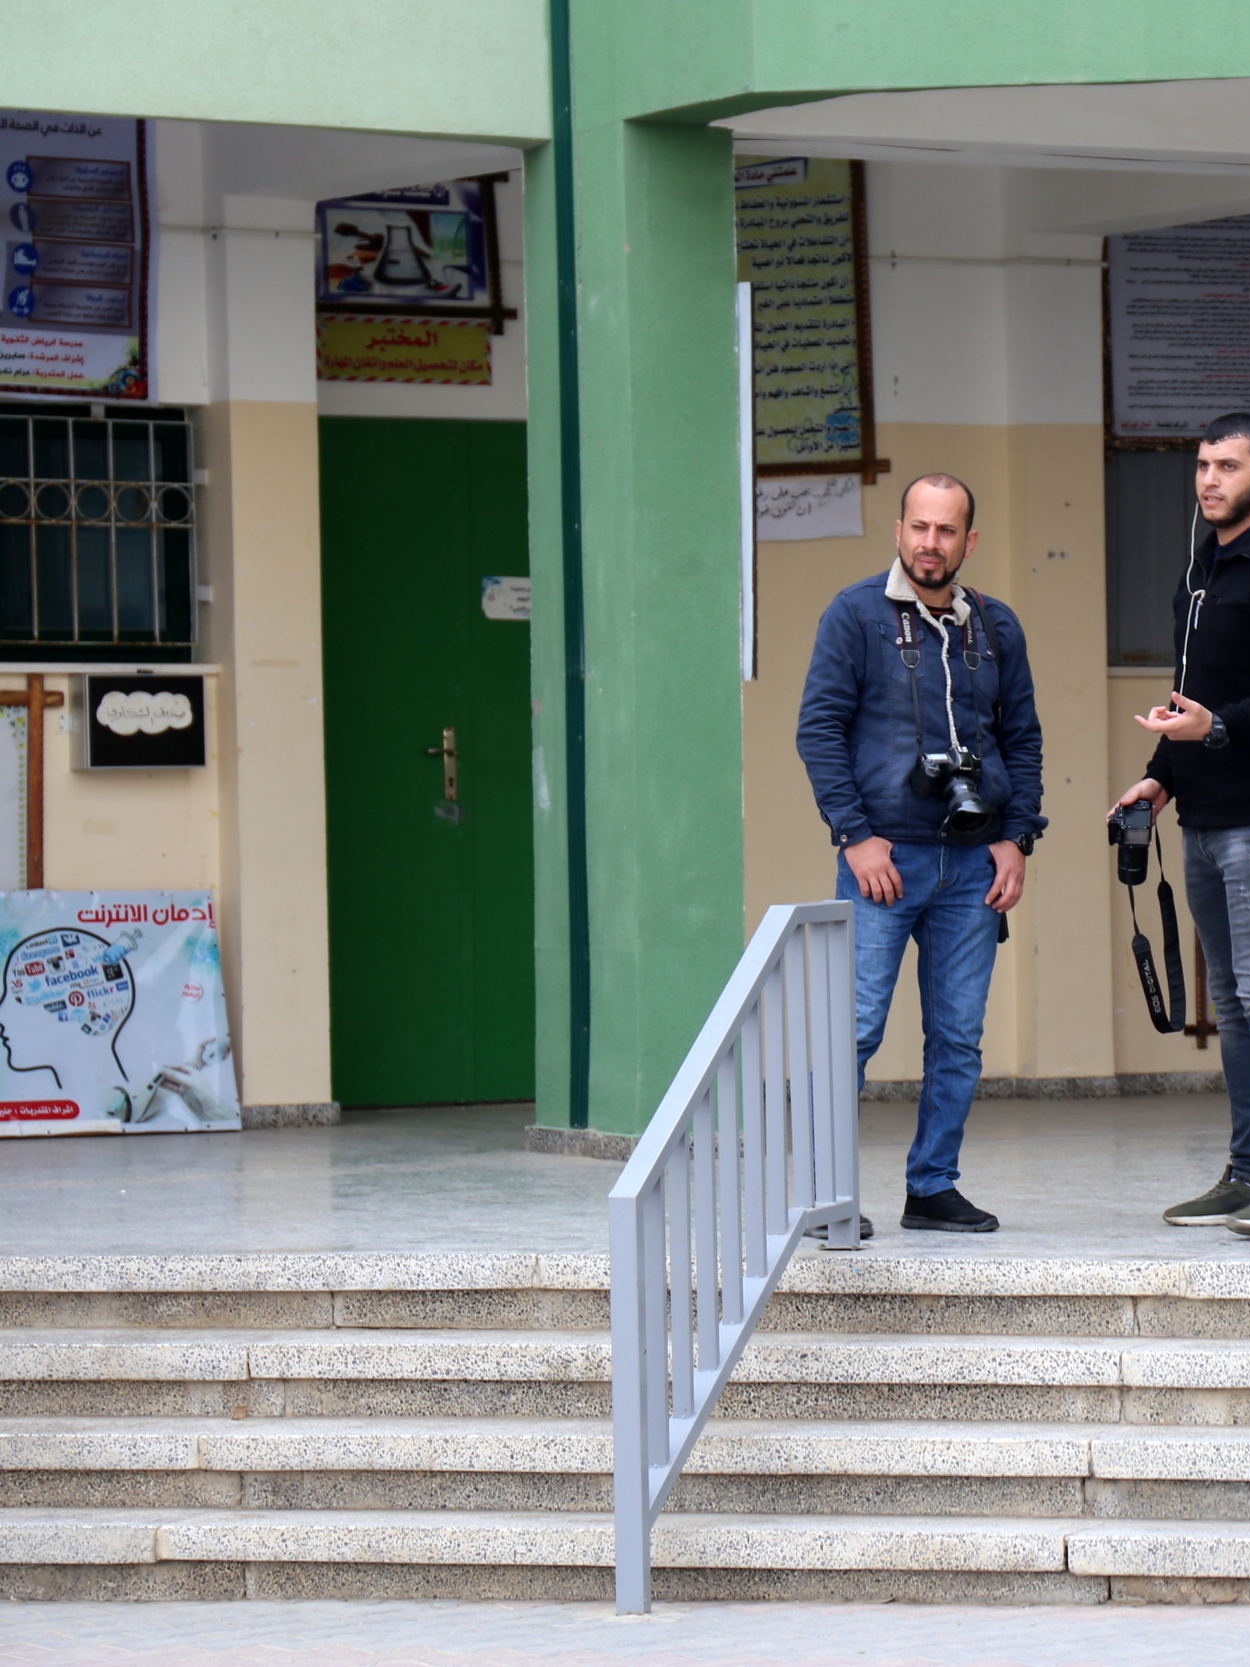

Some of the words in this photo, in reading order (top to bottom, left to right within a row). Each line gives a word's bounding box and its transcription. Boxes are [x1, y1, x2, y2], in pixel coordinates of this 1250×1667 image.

[9, 119, 39, 131] الصحة
[40, 122, 59, 136] في
[60, 121, 86, 134] الذات
[31, 336, 56, 346] الرياض
[58, 338, 83, 347] مدرسة
[366, 328, 439, 353] المختبر
[77, 904, 147, 928] الانترنت
[152, 903, 216, 929] إدمان
[45, 965, 98, 987] facebook
[1143, 959, 1155, 994] DIGITAL
[86, 985, 115, 999] flickr
[1152, 994, 1162, 1013] EOS
